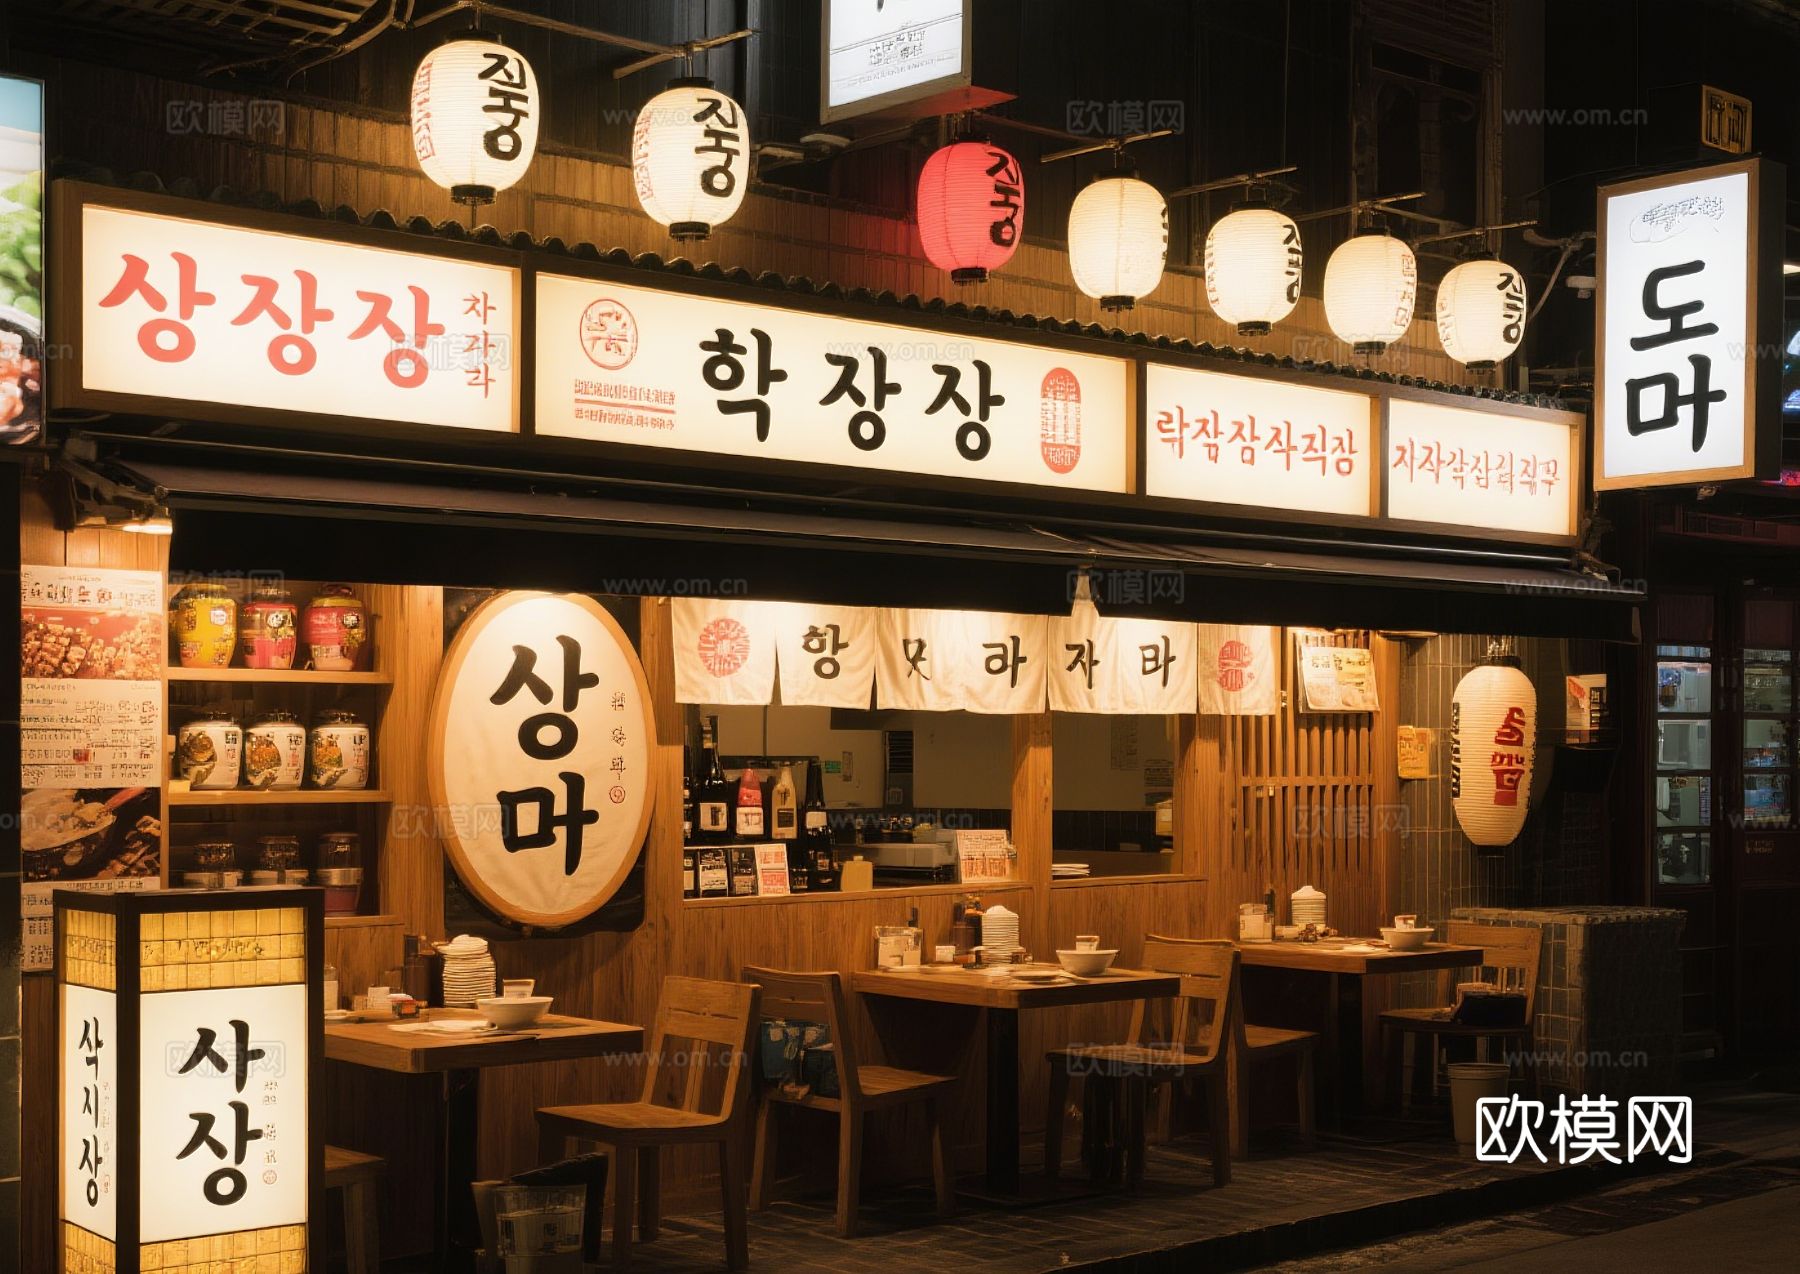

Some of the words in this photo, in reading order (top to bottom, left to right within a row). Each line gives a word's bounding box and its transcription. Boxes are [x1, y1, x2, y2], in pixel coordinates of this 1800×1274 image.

[99, 252, 445, 389] 상장장
[699, 327, 1005, 461] 학장장
[1626, 259, 1727, 452] 도마
[490, 635, 599, 876] 상마
[176, 1019, 266, 1206] 사장
